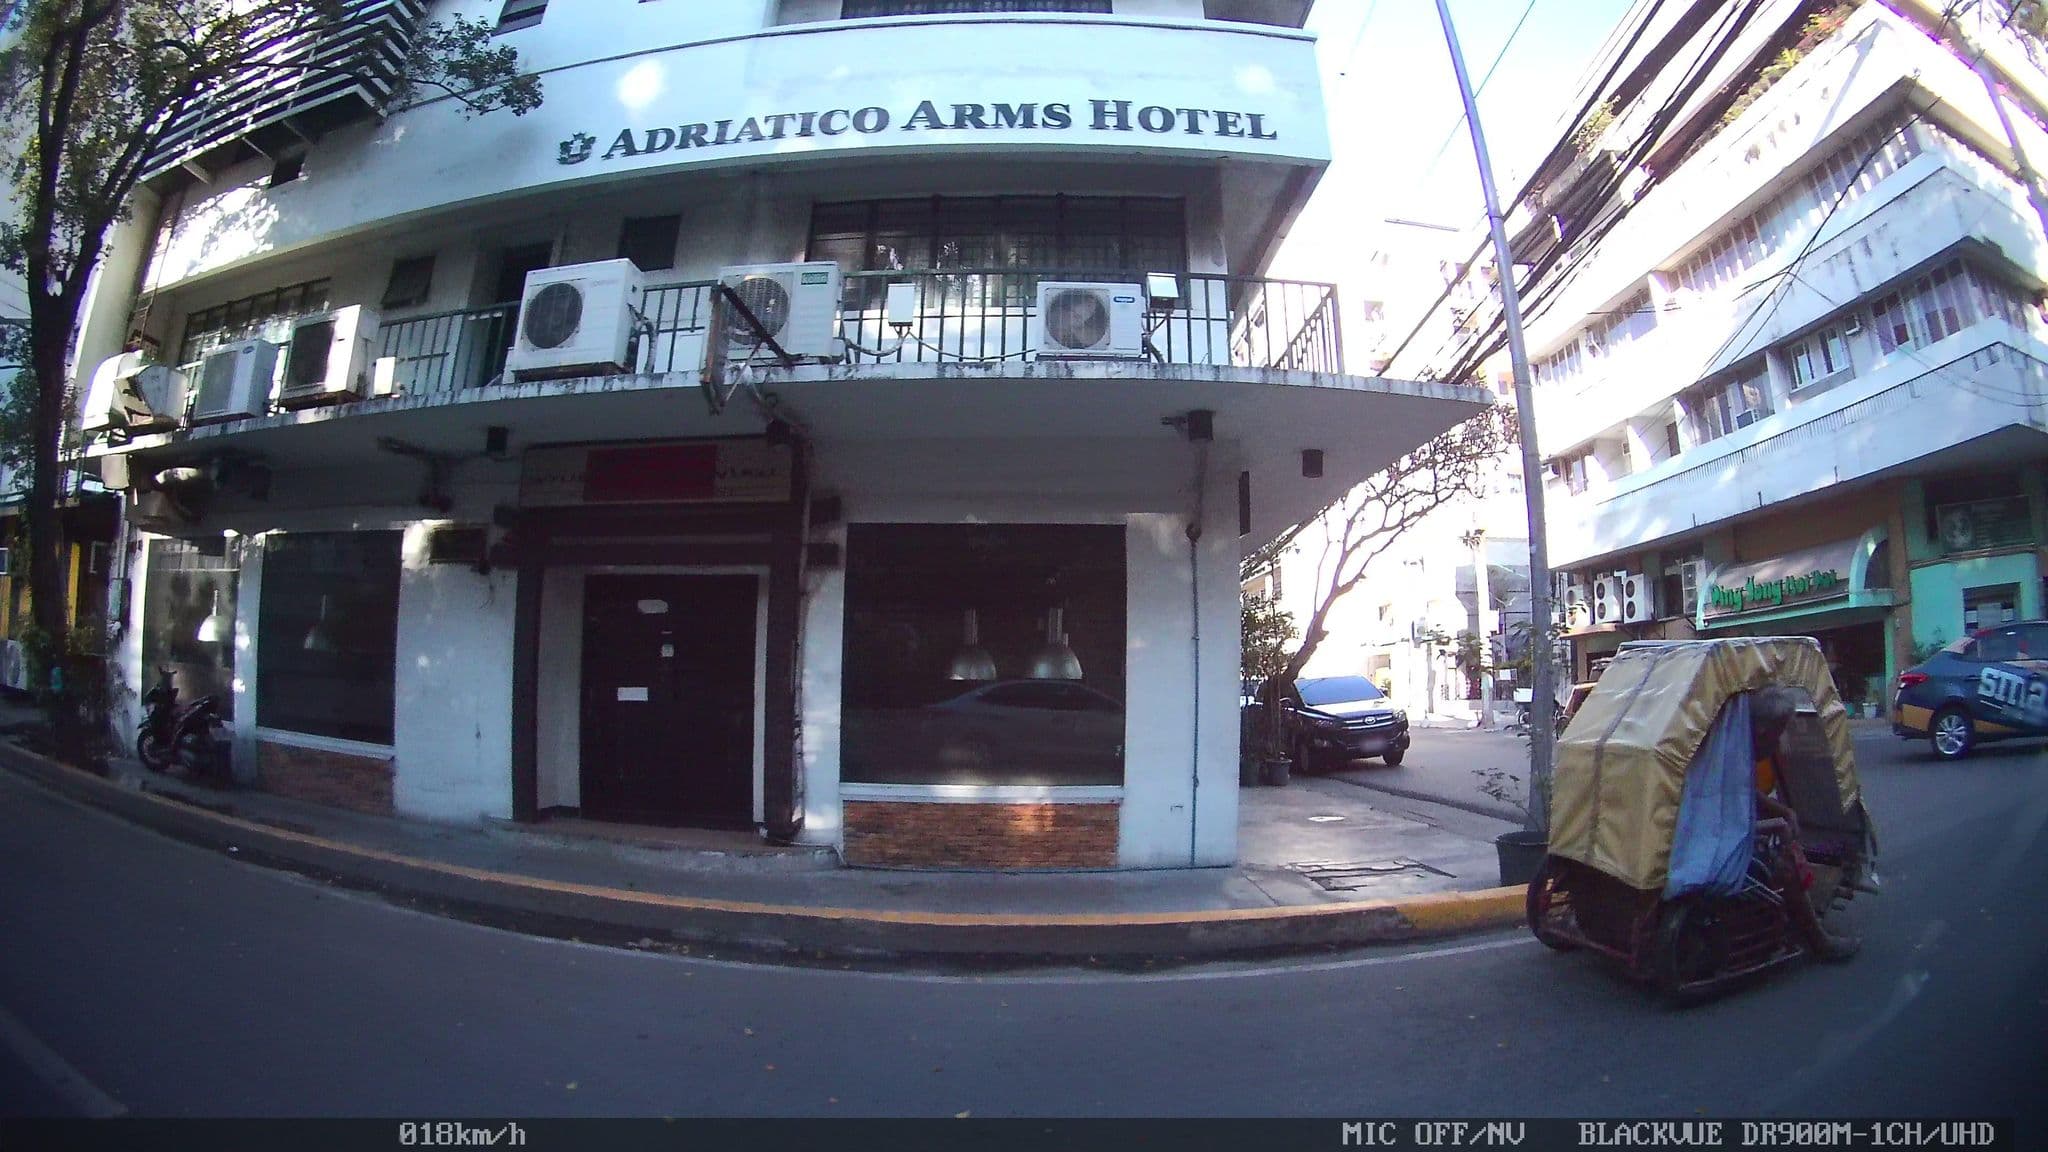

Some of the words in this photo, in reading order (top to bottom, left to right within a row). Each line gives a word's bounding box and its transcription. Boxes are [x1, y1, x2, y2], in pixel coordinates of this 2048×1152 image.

[600, 106, 890, 160] ADRIATICO
[900, 99, 1072, 130] ARMS
[1088, 99, 1278, 140] HOTEL
